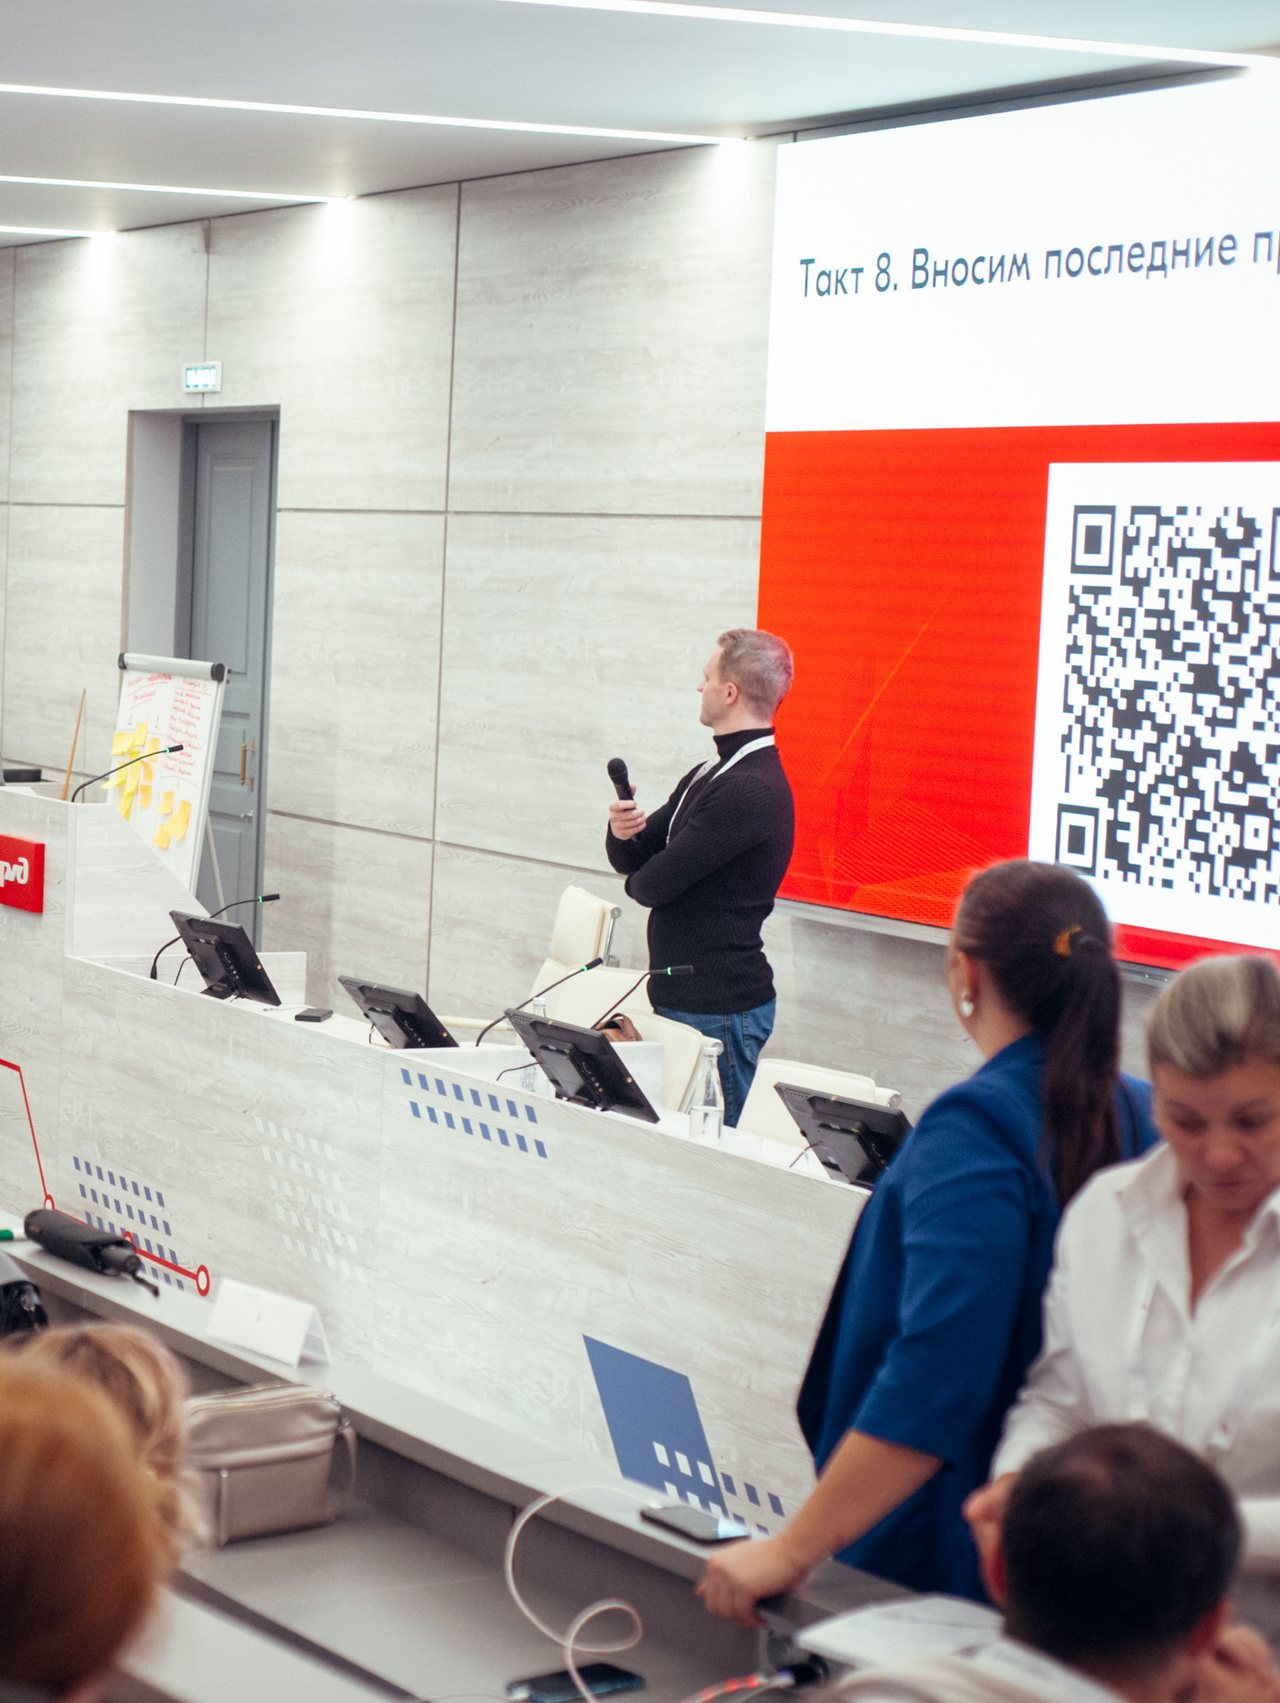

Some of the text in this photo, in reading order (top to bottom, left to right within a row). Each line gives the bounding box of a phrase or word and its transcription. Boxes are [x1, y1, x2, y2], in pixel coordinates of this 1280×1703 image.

[799, 231, 1280, 298] Такт 8. Вносим последние п
